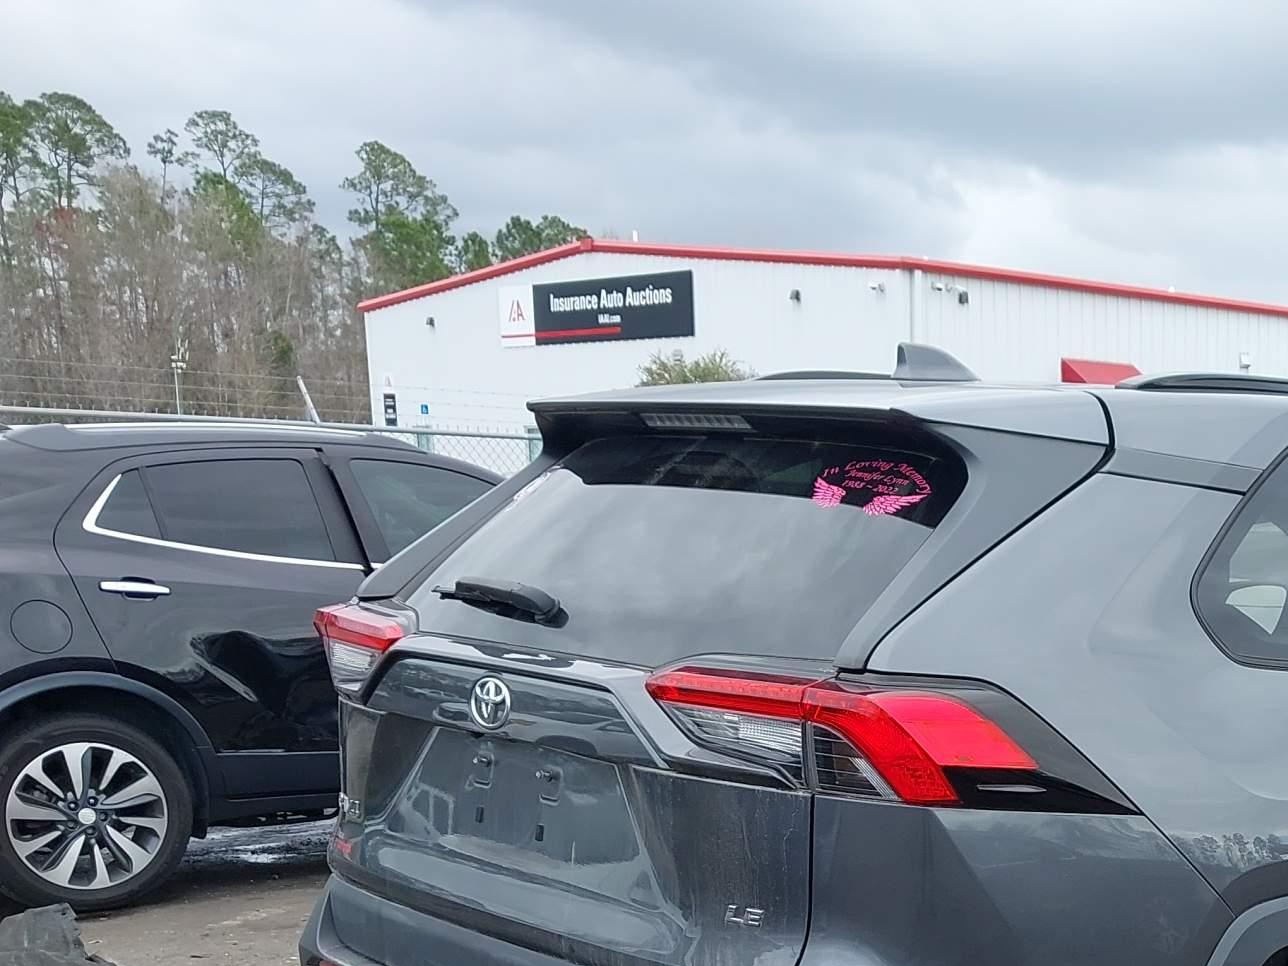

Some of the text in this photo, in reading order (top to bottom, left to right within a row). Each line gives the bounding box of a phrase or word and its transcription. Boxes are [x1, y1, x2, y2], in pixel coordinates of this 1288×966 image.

[550, 285, 673, 312] Insurance Auto Auctions
[822, 459, 932, 495] In Loving Memory
[725, 904, 764, 928] LE
